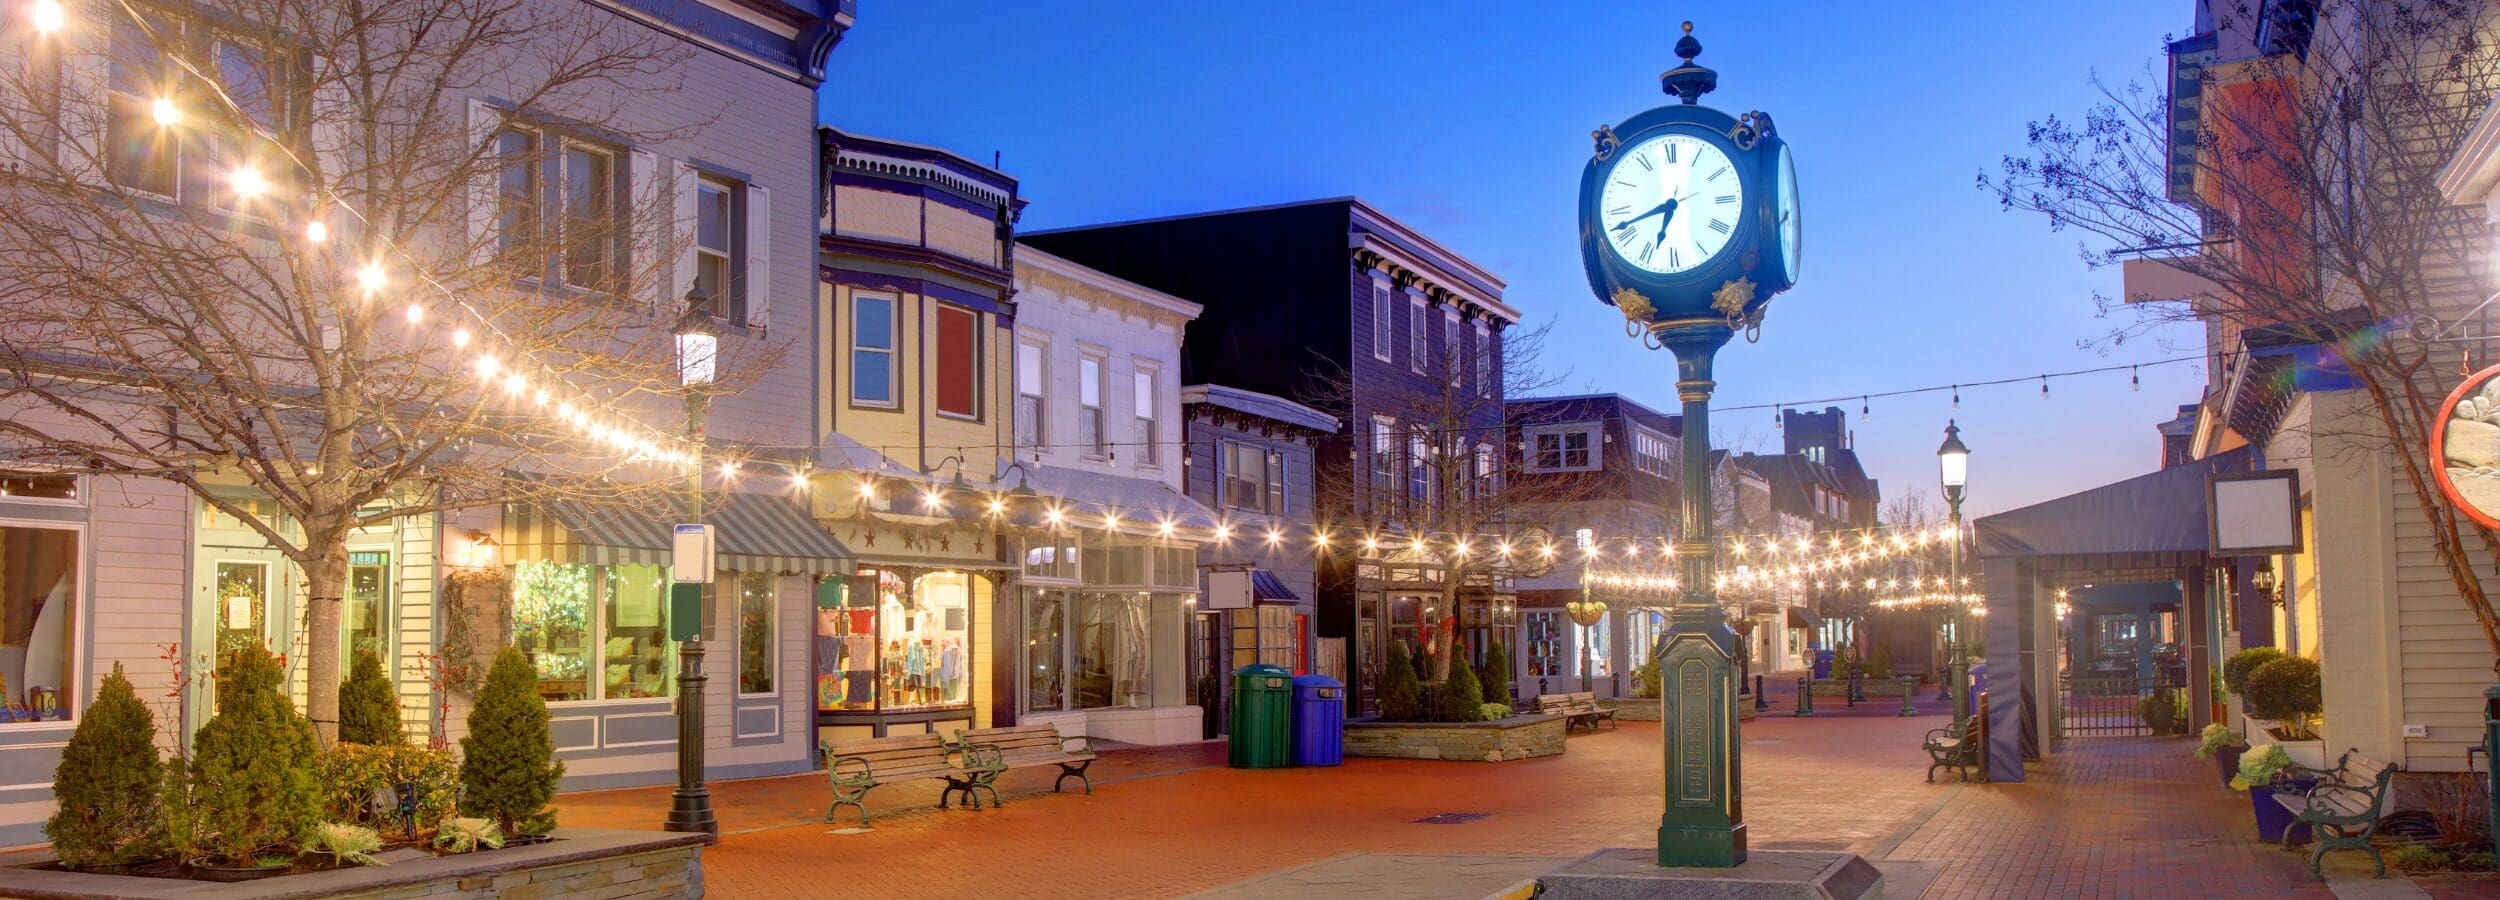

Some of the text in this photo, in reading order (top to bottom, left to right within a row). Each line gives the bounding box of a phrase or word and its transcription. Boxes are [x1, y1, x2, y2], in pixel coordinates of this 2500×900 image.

[1691, 147, 1703, 167] I
[1707, 166, 1727, 182] II
[1715, 194, 1737, 205] III
